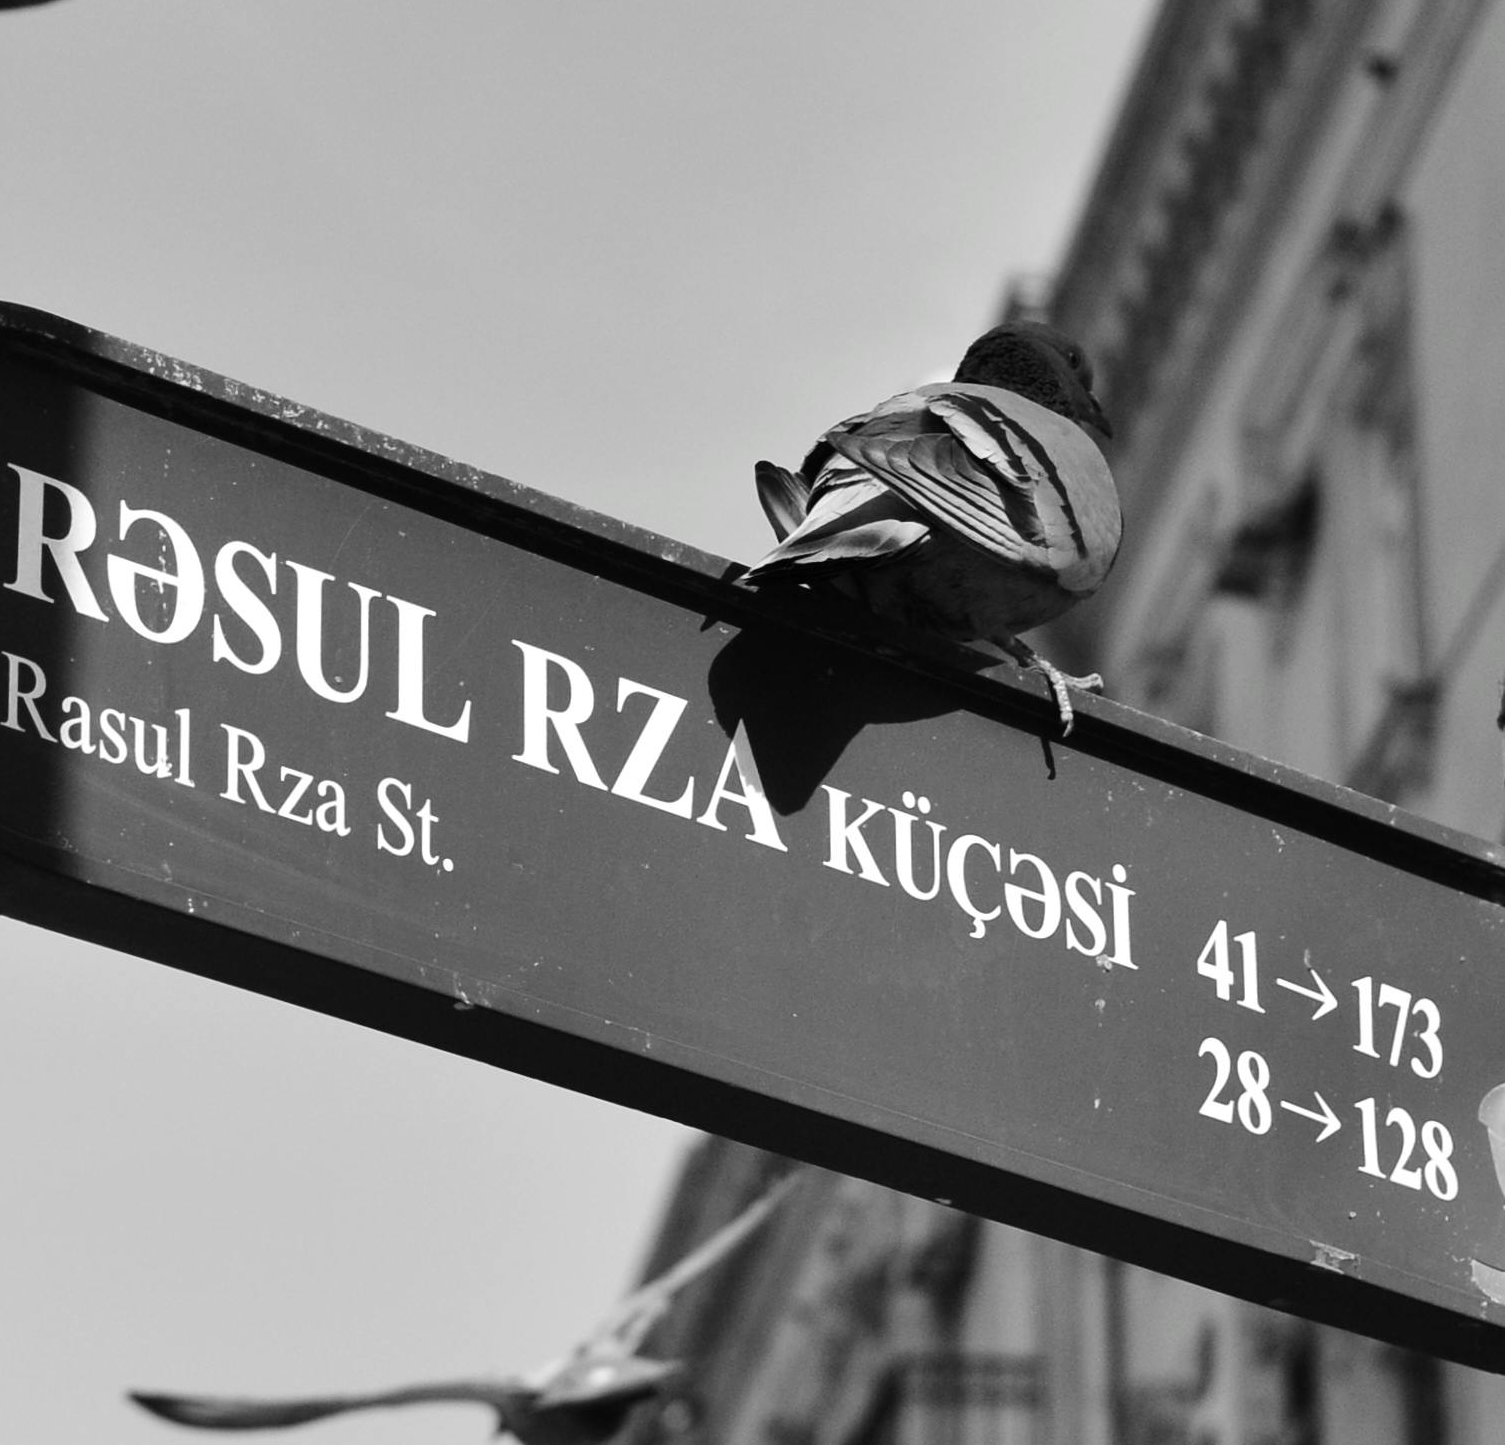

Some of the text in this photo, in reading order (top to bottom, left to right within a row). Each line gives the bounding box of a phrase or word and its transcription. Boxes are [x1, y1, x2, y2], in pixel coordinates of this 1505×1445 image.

[0, 650, 455, 872] Rasul Rza St.
[3, 462, 1139, 970] RƏSUL RZA KÜÇƏSİ
[1197, 919, 1443, 1079] 41 173
[1198, 1037, 1459, 1201] 28 128
